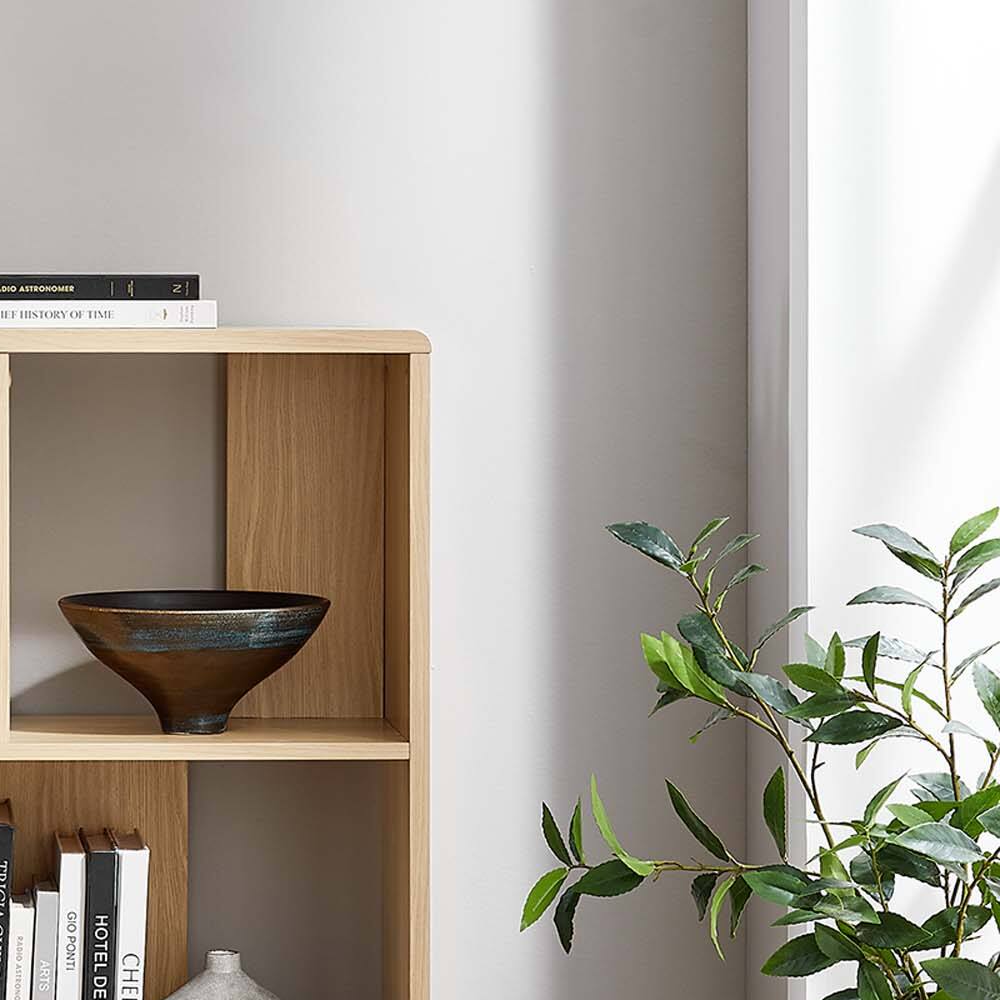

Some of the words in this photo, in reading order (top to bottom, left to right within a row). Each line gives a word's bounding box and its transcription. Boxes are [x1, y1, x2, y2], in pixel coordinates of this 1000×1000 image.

[19, 285, 75, 293] ASTRONOMER
[19, 310, 68, 319] HISTORY
[70, 310, 86, 319] OF
[87, 310, 115, 319] TIME
[66, 911, 77, 933] GIO
[15, 936, 23, 961] RADIO
[66, 936, 76, 971] PONTI
[94, 914, 109, 973] HOTEL
[38, 959, 50, 991] ARTS
